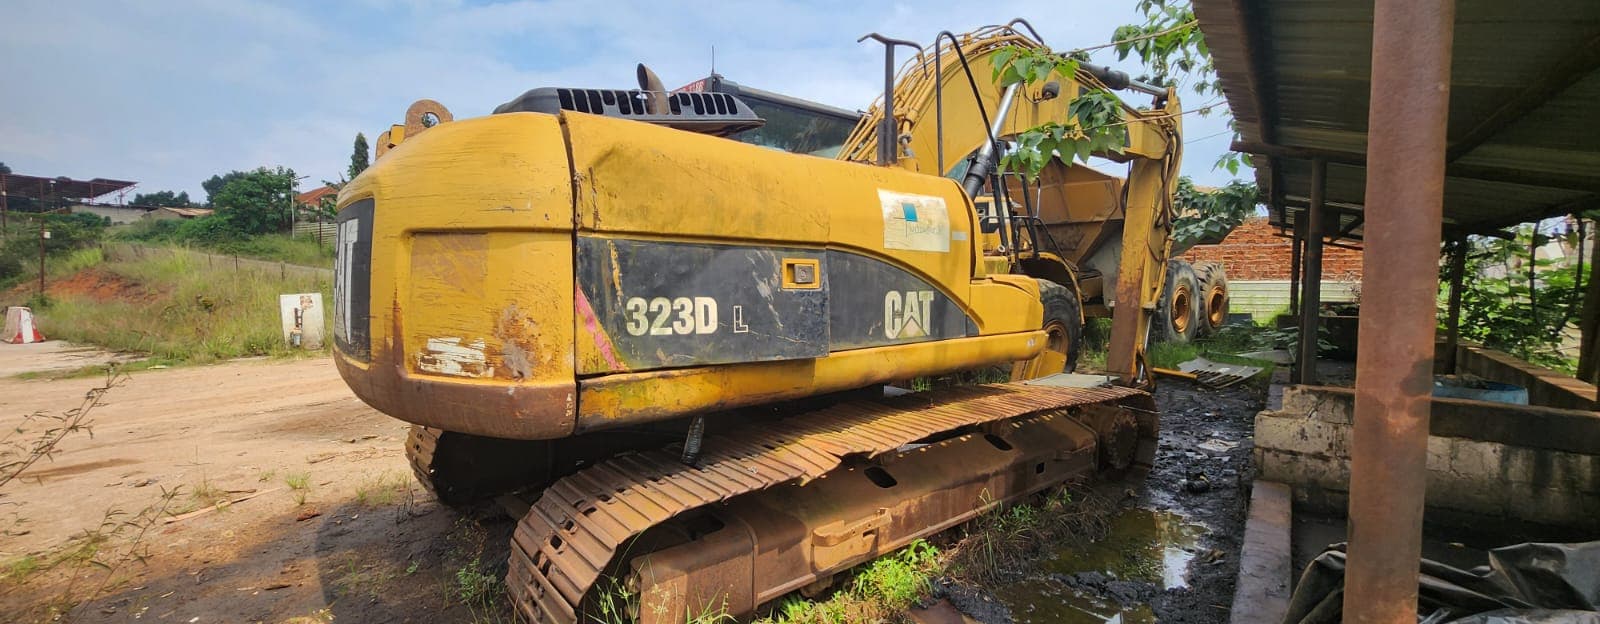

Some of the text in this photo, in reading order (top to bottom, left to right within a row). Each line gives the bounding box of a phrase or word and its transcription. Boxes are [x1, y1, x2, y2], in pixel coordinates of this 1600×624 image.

[334, 218, 358, 344] AT
[626, 297, 749, 336] 323D L
[885, 290, 935, 339] CAT
